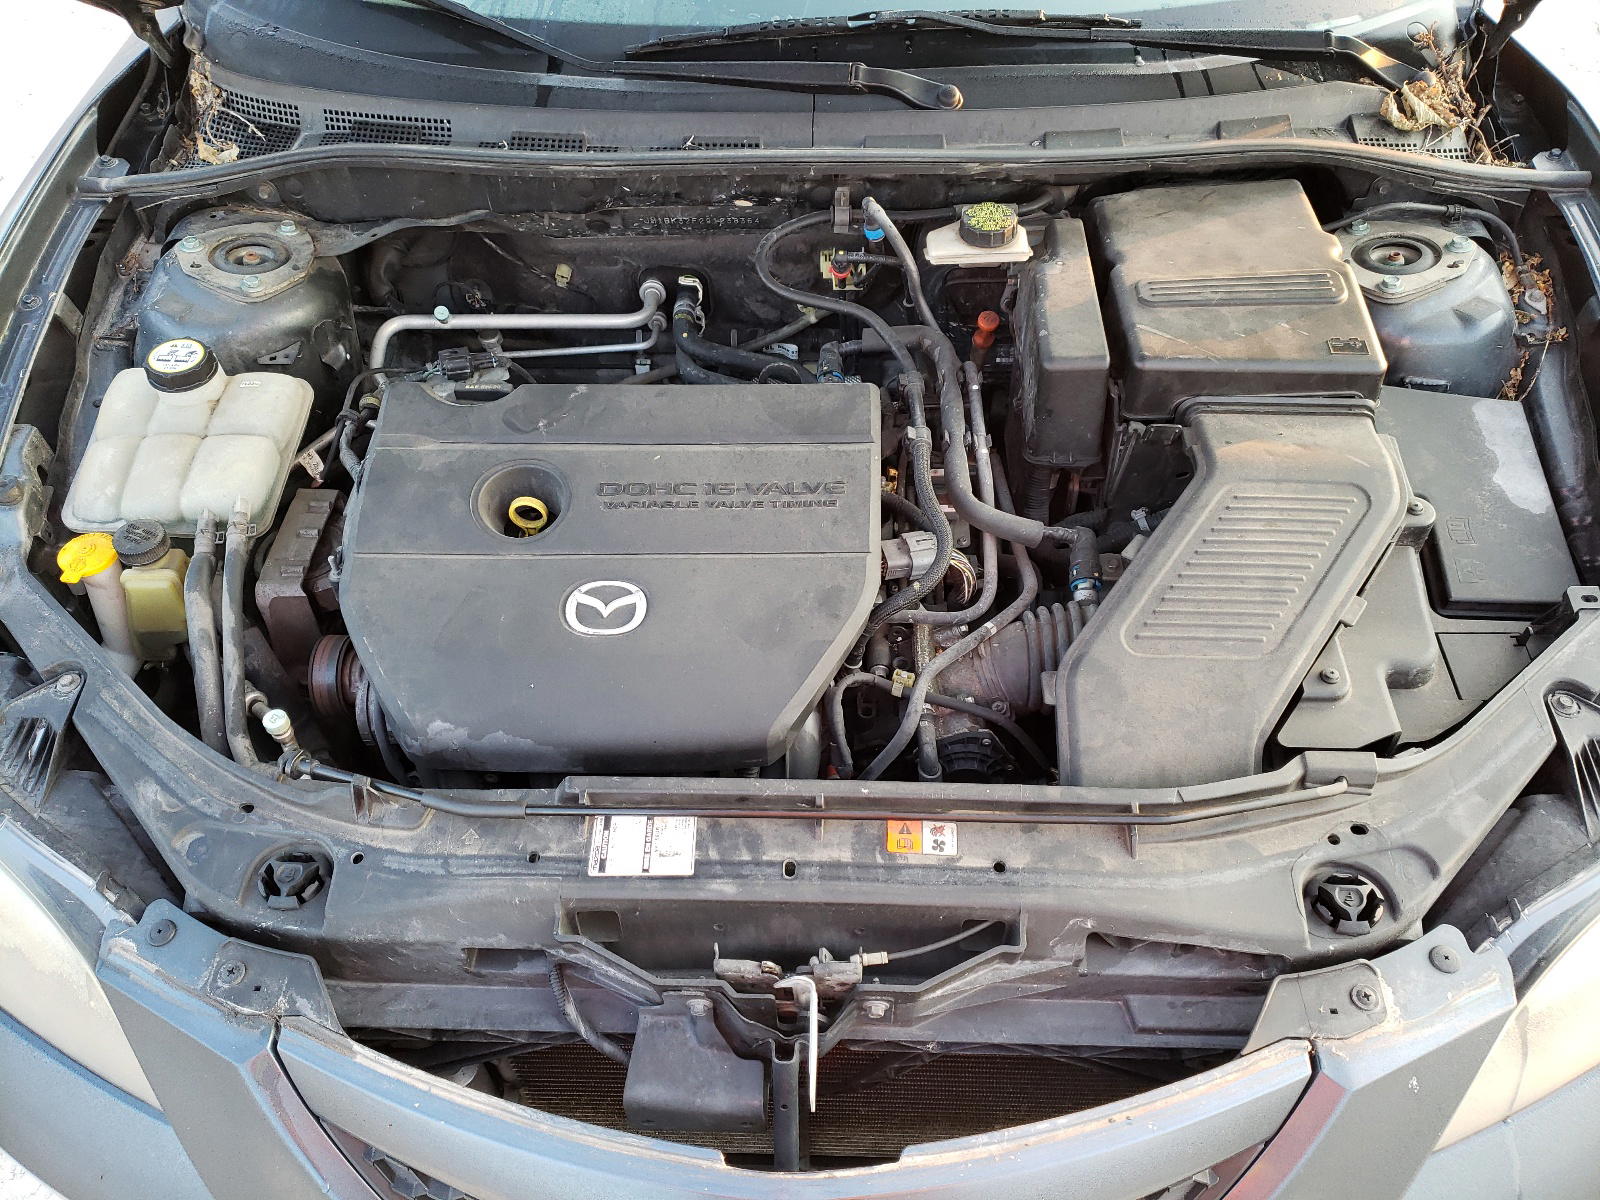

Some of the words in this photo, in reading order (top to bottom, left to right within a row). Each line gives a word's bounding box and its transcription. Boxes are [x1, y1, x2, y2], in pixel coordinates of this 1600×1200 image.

[597, 482, 698, 497] DOHC
[703, 480, 848, 496] 16-VALVE
[601, 499, 700, 510] VARIABLE
[704, 499, 765, 509] VALVE
[768, 499, 838, 508] TIMING
[601, 830, 609, 859] CAUTION
